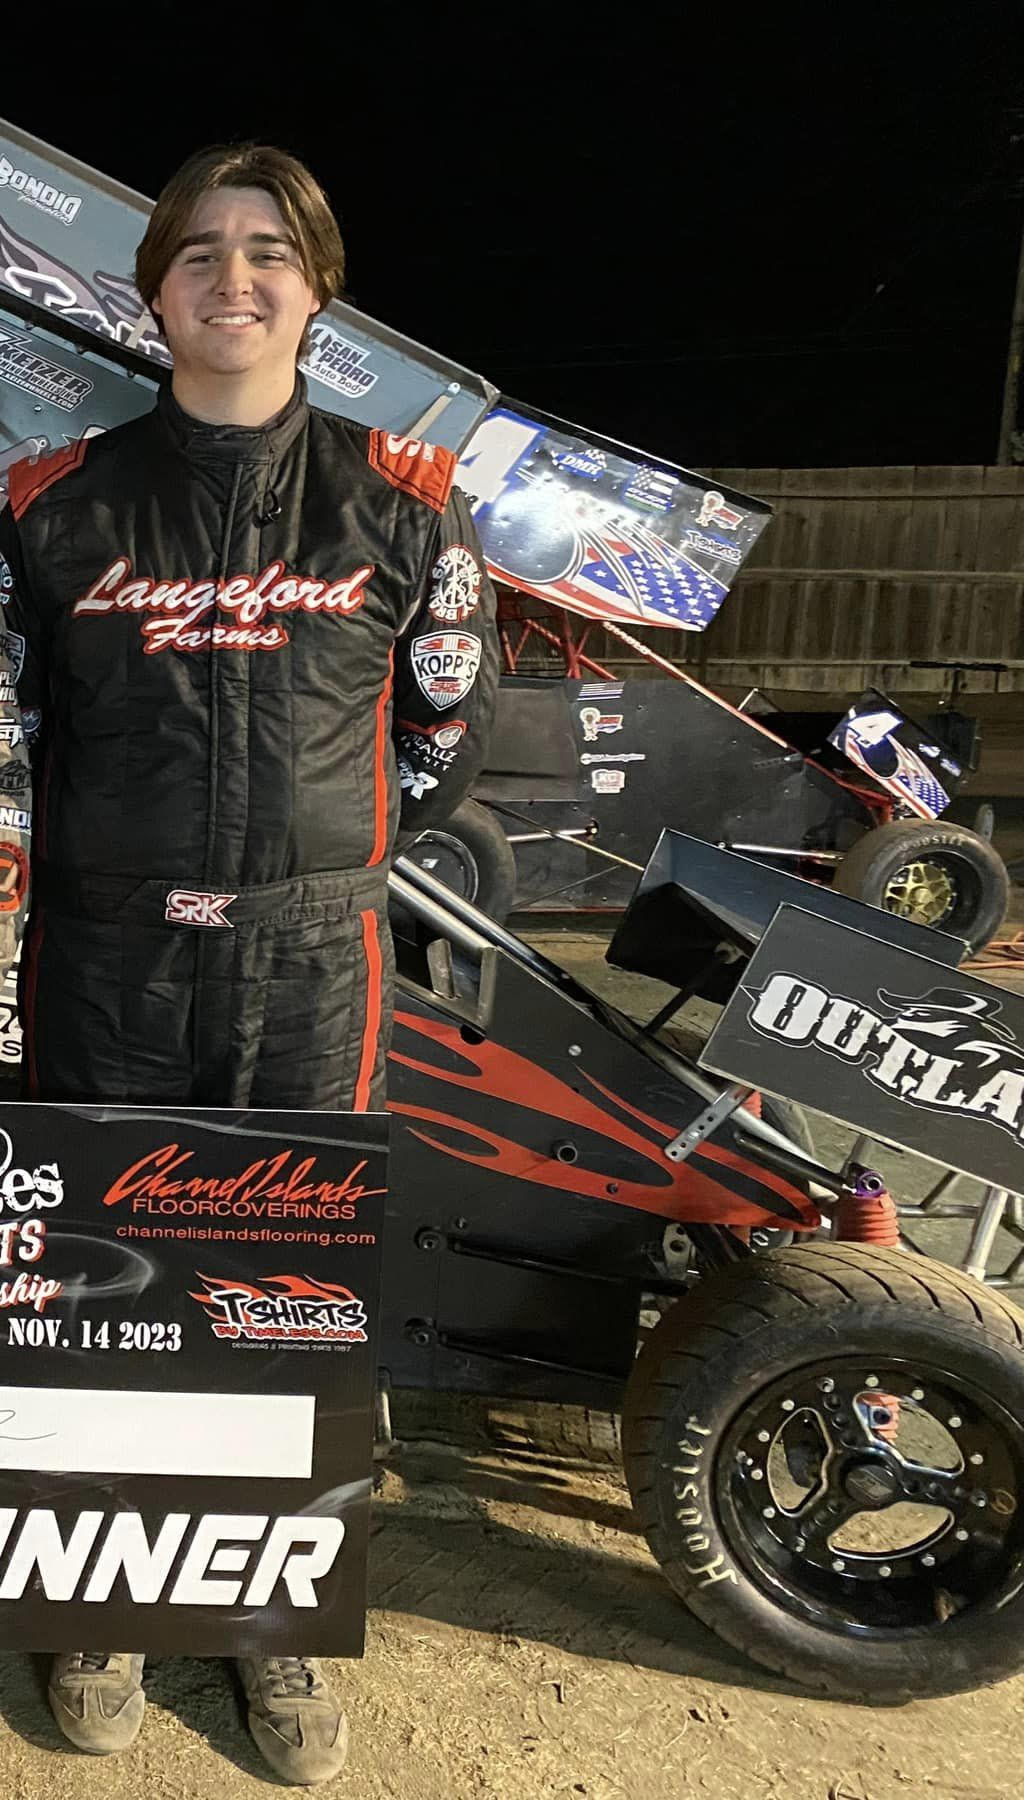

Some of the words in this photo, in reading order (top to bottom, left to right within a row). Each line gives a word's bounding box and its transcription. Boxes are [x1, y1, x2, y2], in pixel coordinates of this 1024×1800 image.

[317, 351, 376, 387] PEDRO
[328, 341, 364, 364] SAN
[561, 455, 603, 475] DMR
[75, 560, 374, 623] Langeford
[143, 618, 286, 652] Farms
[416, 653, 477, 681] KOPP'S
[166, 890, 236, 927] SRK
[751, 974, 1024, 1141] OUTLA
[103, 1143, 259, 1206] Channel
[243, 1150, 388, 1203] Islands
[132, 1199, 356, 1220] FLOORCOVERINGS
[116, 1224, 376, 1246] channelislandsflooring.com
[212, 1289, 368, 1329] TSHIRTS
[7, 1317, 69, 1348] NOV.
[81, 1320, 110, 1349] 14
[119, 1321, 182, 1352] 2023
[675, 1414, 741, 1588] Hoosier
